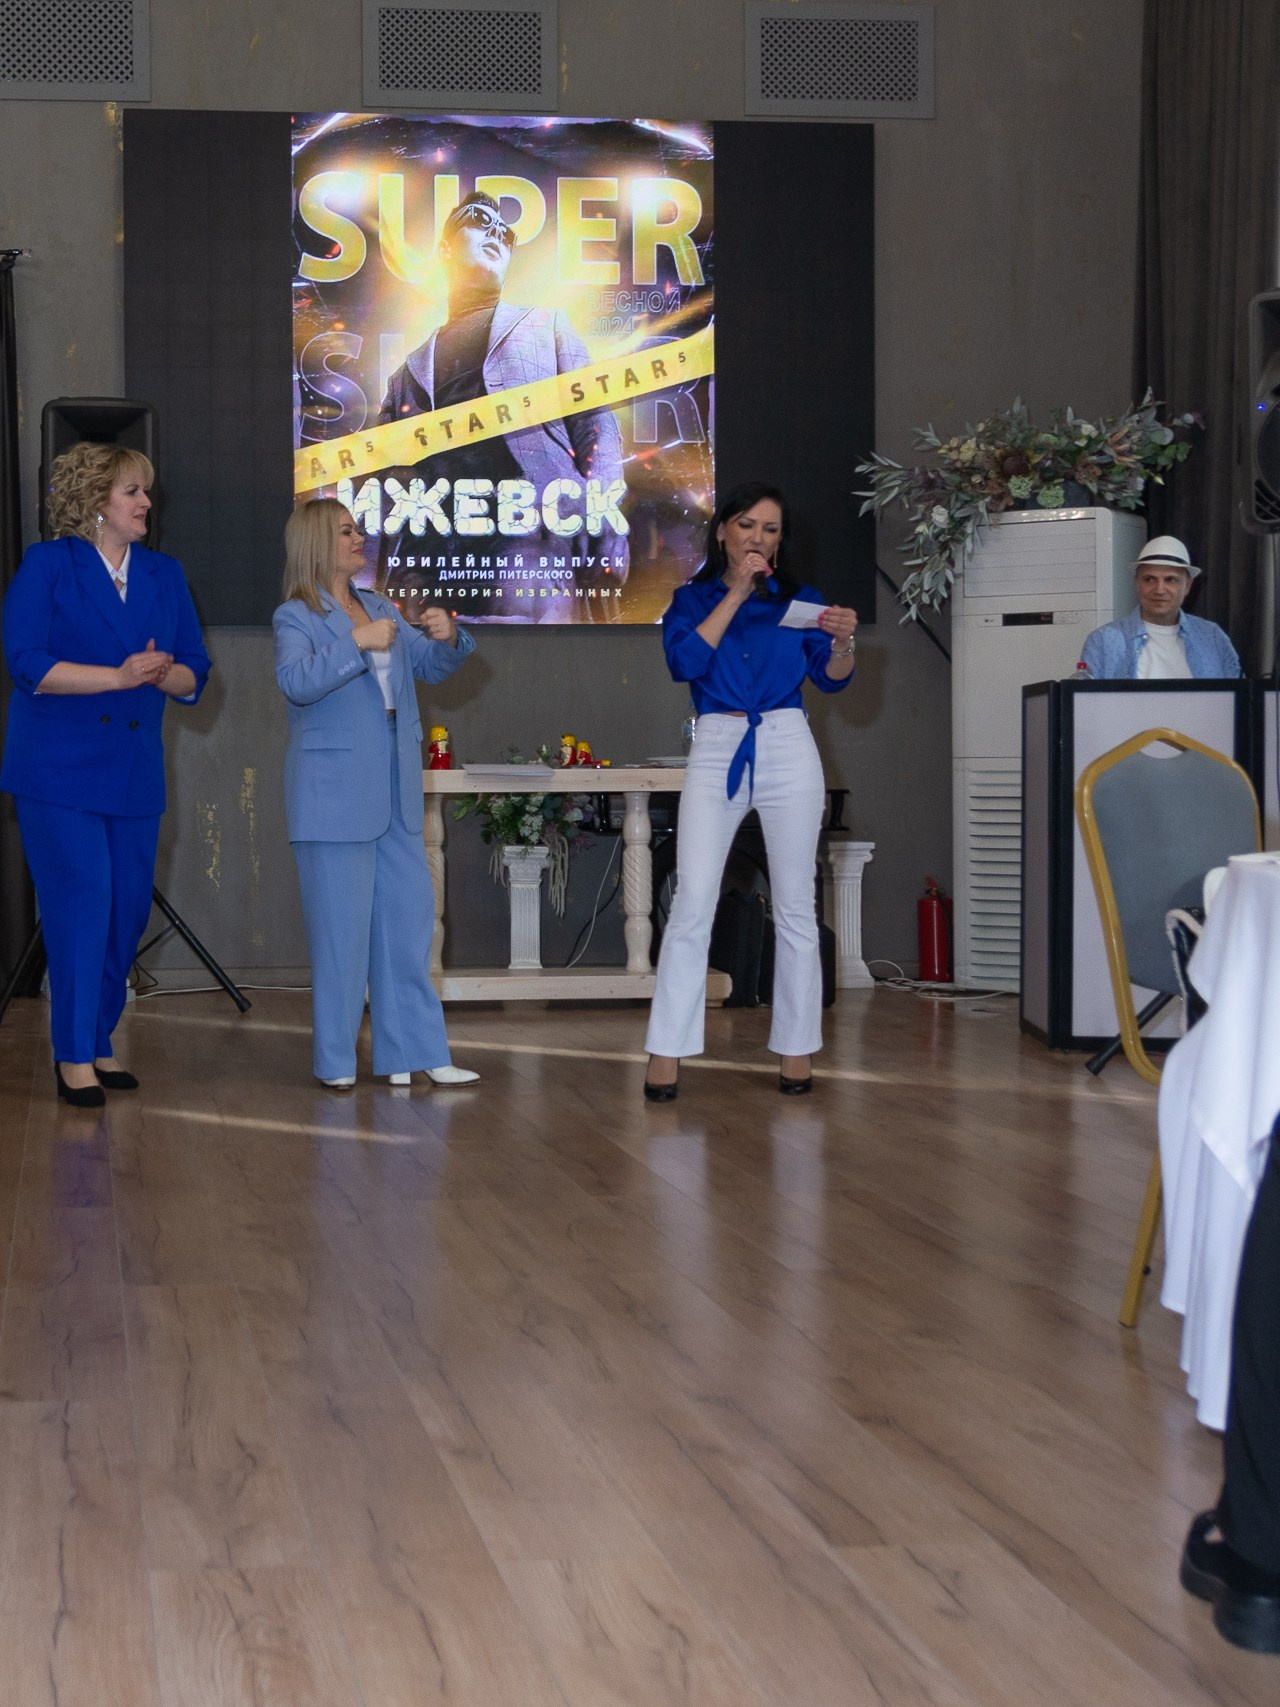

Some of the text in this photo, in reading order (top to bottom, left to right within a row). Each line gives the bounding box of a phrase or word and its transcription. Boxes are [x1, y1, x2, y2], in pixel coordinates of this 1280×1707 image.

[296, 170, 706, 287] SUPER
[586, 286, 681, 313] ВЕСНОЙ
[588, 316, 635, 337] 2024
[336, 477, 631, 537] ИЖЕВСК
[387, 554, 625, 568] ЮБИЛЕЙНЫЙ ВЫПУСК
[439, 569, 573, 581] ДМИТРИЯ ПИТЕРСКОГО
[387, 588, 622, 598] ТЕРРИТОРИЯ ИЗБРАННЫХ
